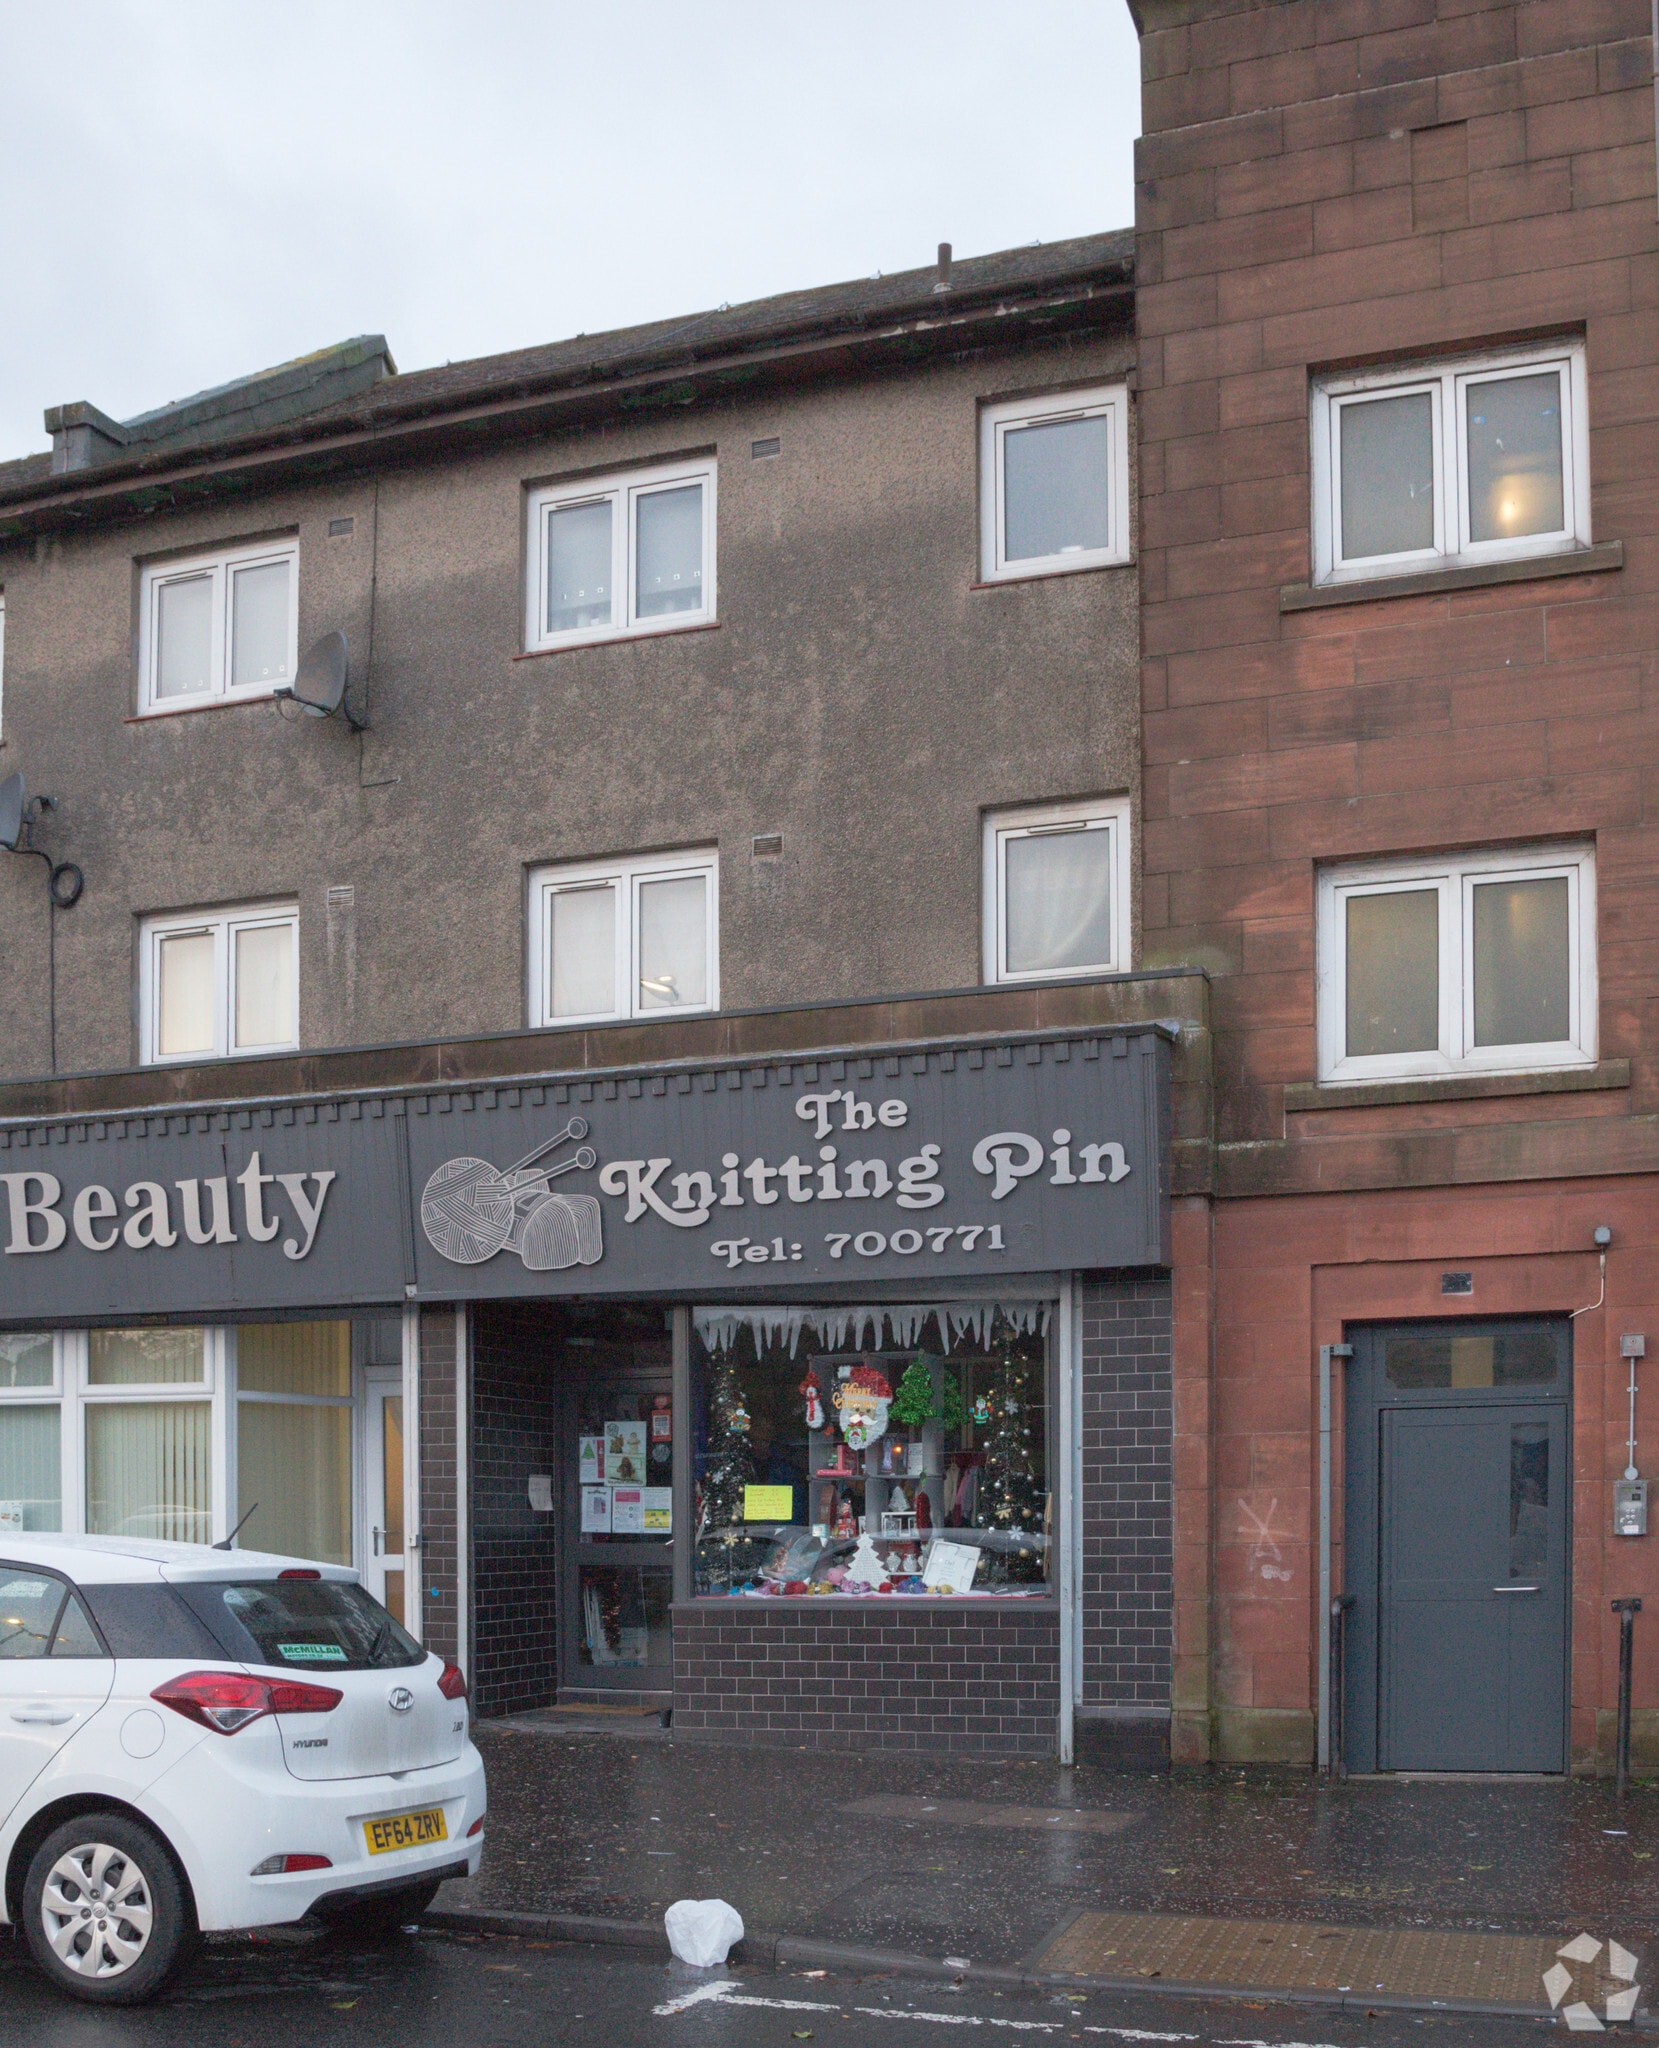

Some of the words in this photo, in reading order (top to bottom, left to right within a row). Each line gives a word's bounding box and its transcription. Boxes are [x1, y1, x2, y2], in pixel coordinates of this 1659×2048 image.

[795, 1089, 908, 1140] The
[598, 1144, 945, 1227] Knitting
[972, 1128, 1131, 1200] Pin
[0, 1150, 336, 1260] Beauty
[710, 1237, 803, 1268] Tel:
[824, 1224, 1006, 1258] 700771
[371, 1818, 413, 1848] EF64
[413, 1812, 441, 1840] ZRV
